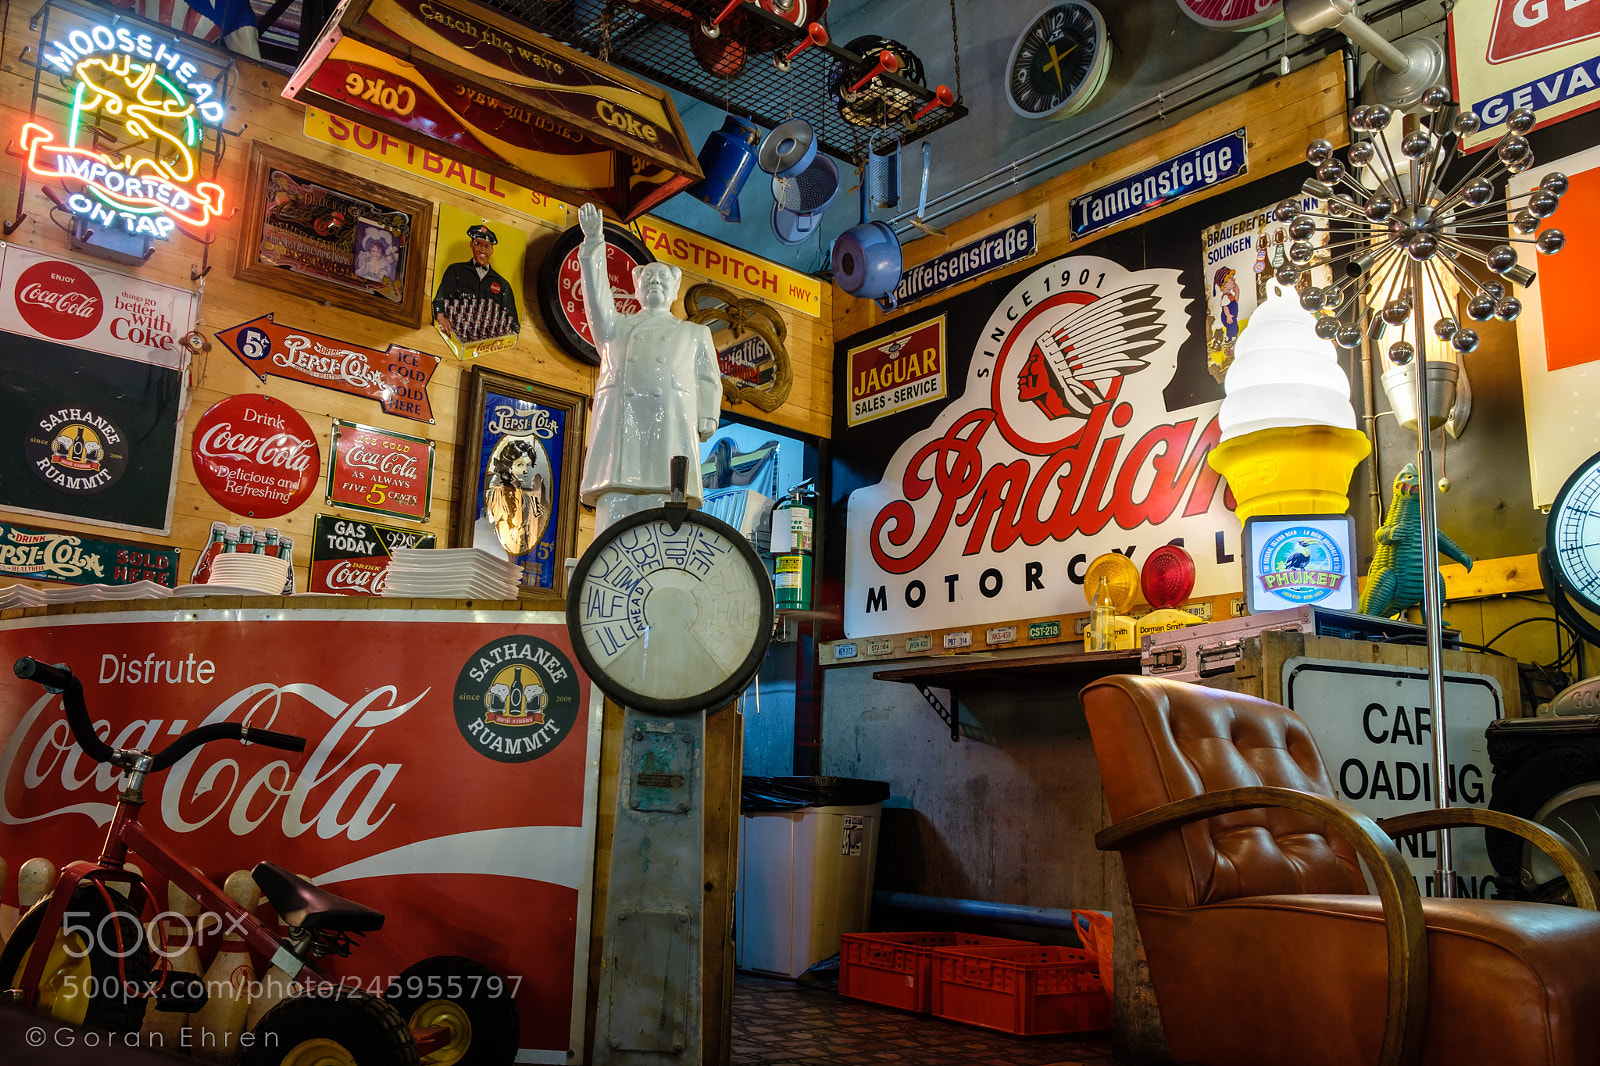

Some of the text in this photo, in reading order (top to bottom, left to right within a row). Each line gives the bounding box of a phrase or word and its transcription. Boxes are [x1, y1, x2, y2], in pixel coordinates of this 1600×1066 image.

[1051, 12, 1065, 30] 12
[419, 3, 566, 76] Catch the wave
[44, 25, 225, 122] MOOSEHEAD
[1481, 62, 1600, 125] GEVA
[595, 99, 660, 143] Coke
[56, 153, 191, 211] IMPORTED
[1079, 145, 1233, 228] Tannensteige
[531, 190, 549, 208] ST
[67, 192, 175, 239] ON TAP
[1207, 217, 1256, 248] BRAUEREI
[1207, 235, 1252, 266] SOLINGEN
[642, 225, 812, 303] FASTPITCH HWY
[50, 272, 76, 284] ENJOY
[562, 278, 572, 290] 9
[20, 282, 98, 319] Coca-Cola
[114, 296, 156, 318] better
[121, 291, 157, 308] things go
[566, 301, 575, 313] 8
[109, 317, 174, 351] Coke
[131, 313, 172, 334] with
[580, 321, 588, 333] 7
[977, 269, 1106, 380] SINCE 1901
[398, 351, 420, 367] ICE
[853, 346, 938, 397] JAGUAR
[387, 363, 426, 382] COLD
[389, 397, 422, 415] HERE
[855, 394, 885, 416] SALES
[893, 378, 938, 404] SERVICE
[39, 407, 121, 445] SATHANEE
[243, 408, 286, 430] Drink
[29, 436, 49, 446] since
[199, 421, 316, 472] Coca-Cola
[359, 436, 410, 453] ICE COLD
[36, 457, 112, 490] RUAMMIT
[345, 445, 418, 480] Coca-Cola
[216, 465, 301, 491] Delicious and
[351, 470, 411, 489] AS ALWAYS
[223, 479, 293, 505] Refreshing
[342, 482, 418, 505] FIVE 5 CENTS
[15, 533, 47, 542] DRINK
[334, 520, 367, 539] GAS
[327, 534, 377, 555] TODAY
[116, 549, 170, 570] SOLD
[352, 562, 382, 571] DRINK
[113, 565, 170, 588] HERE
[325, 560, 389, 596] Coca-C
[1264, 571, 1341, 589] PHUKET
[630, 586, 646, 632] AHEAD
[595, 625, 636, 657] ULL
[1029, 625, 1059, 638] CST-218
[1140, 624, 1165, 634] Dorman
[98, 652, 216, 685] Disfrute
[469, 643, 569, 684] SATHANEE
[459, 692, 481, 701] since
[467, 716, 561, 755] RUAMMIT
[1362, 702, 1433, 746] CAR
[0, 682, 431, 841] Coca-Cola
[1338, 757, 1486, 805] OADIG
